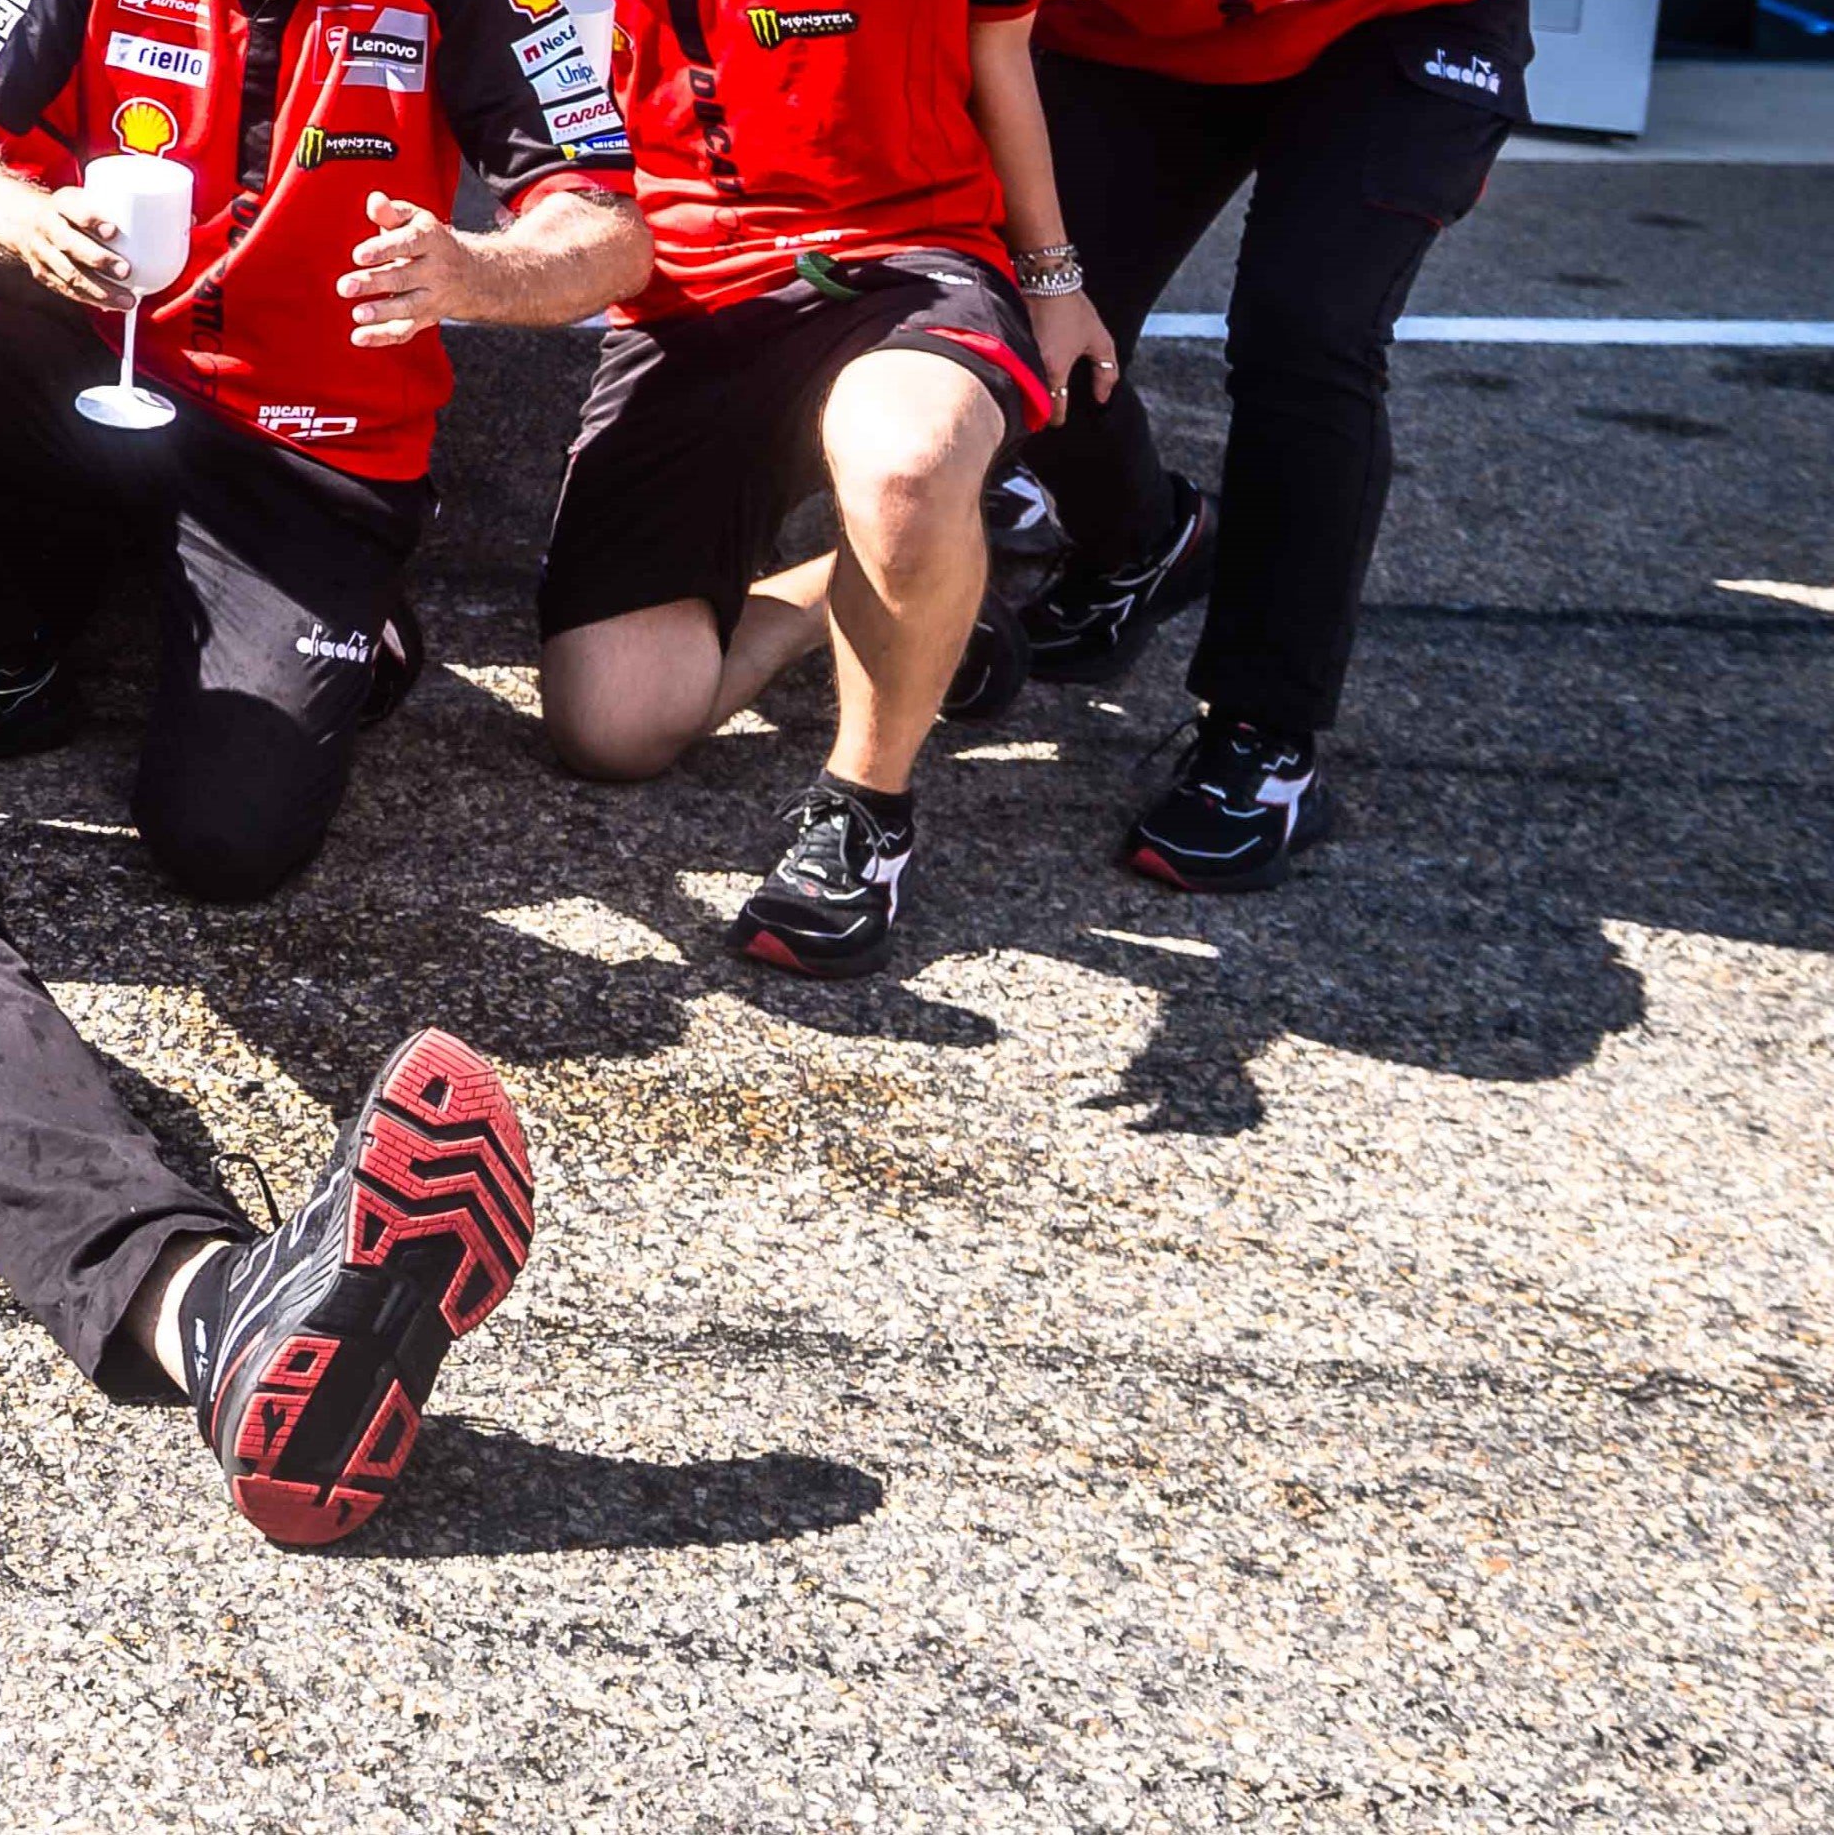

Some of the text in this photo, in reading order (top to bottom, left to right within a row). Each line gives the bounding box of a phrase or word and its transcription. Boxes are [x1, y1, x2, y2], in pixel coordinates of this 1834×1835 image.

[780, 12, 853, 28] MONSTER
[352, 36, 417, 59] Lenovo
[540, 26, 577, 52] NetA
[138, 45, 202, 74] riello
[557, 64, 593, 84] Unip
[325, 136, 392, 153] MONSTER
[259, 405, 317, 418] DUCATI
